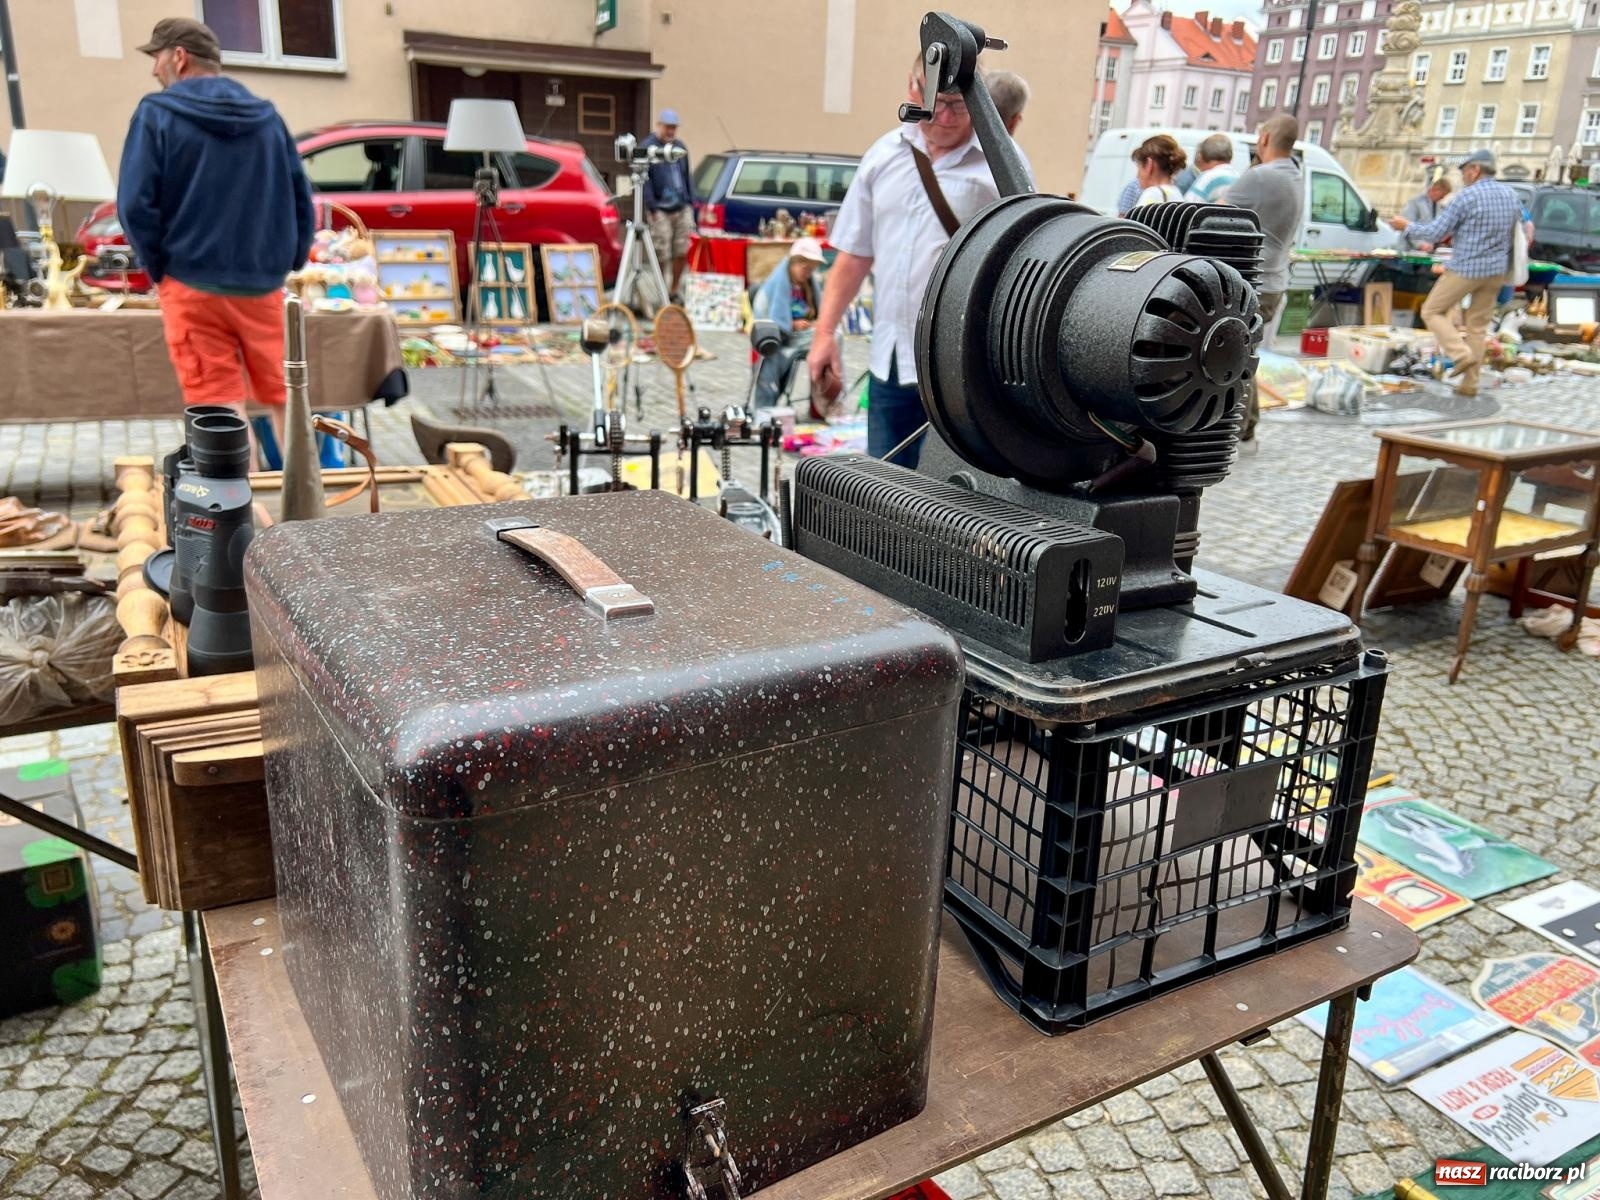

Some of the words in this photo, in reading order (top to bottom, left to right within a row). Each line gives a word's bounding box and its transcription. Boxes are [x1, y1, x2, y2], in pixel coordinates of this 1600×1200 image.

[1097, 576, 1117, 588] 120V
[1093, 604, 1115, 617] 220V
[1478, 1067, 1517, 1092] FRESH
[1436, 1086, 1479, 1112] TASTY
[1469, 1082, 1567, 1152] Sandwich
